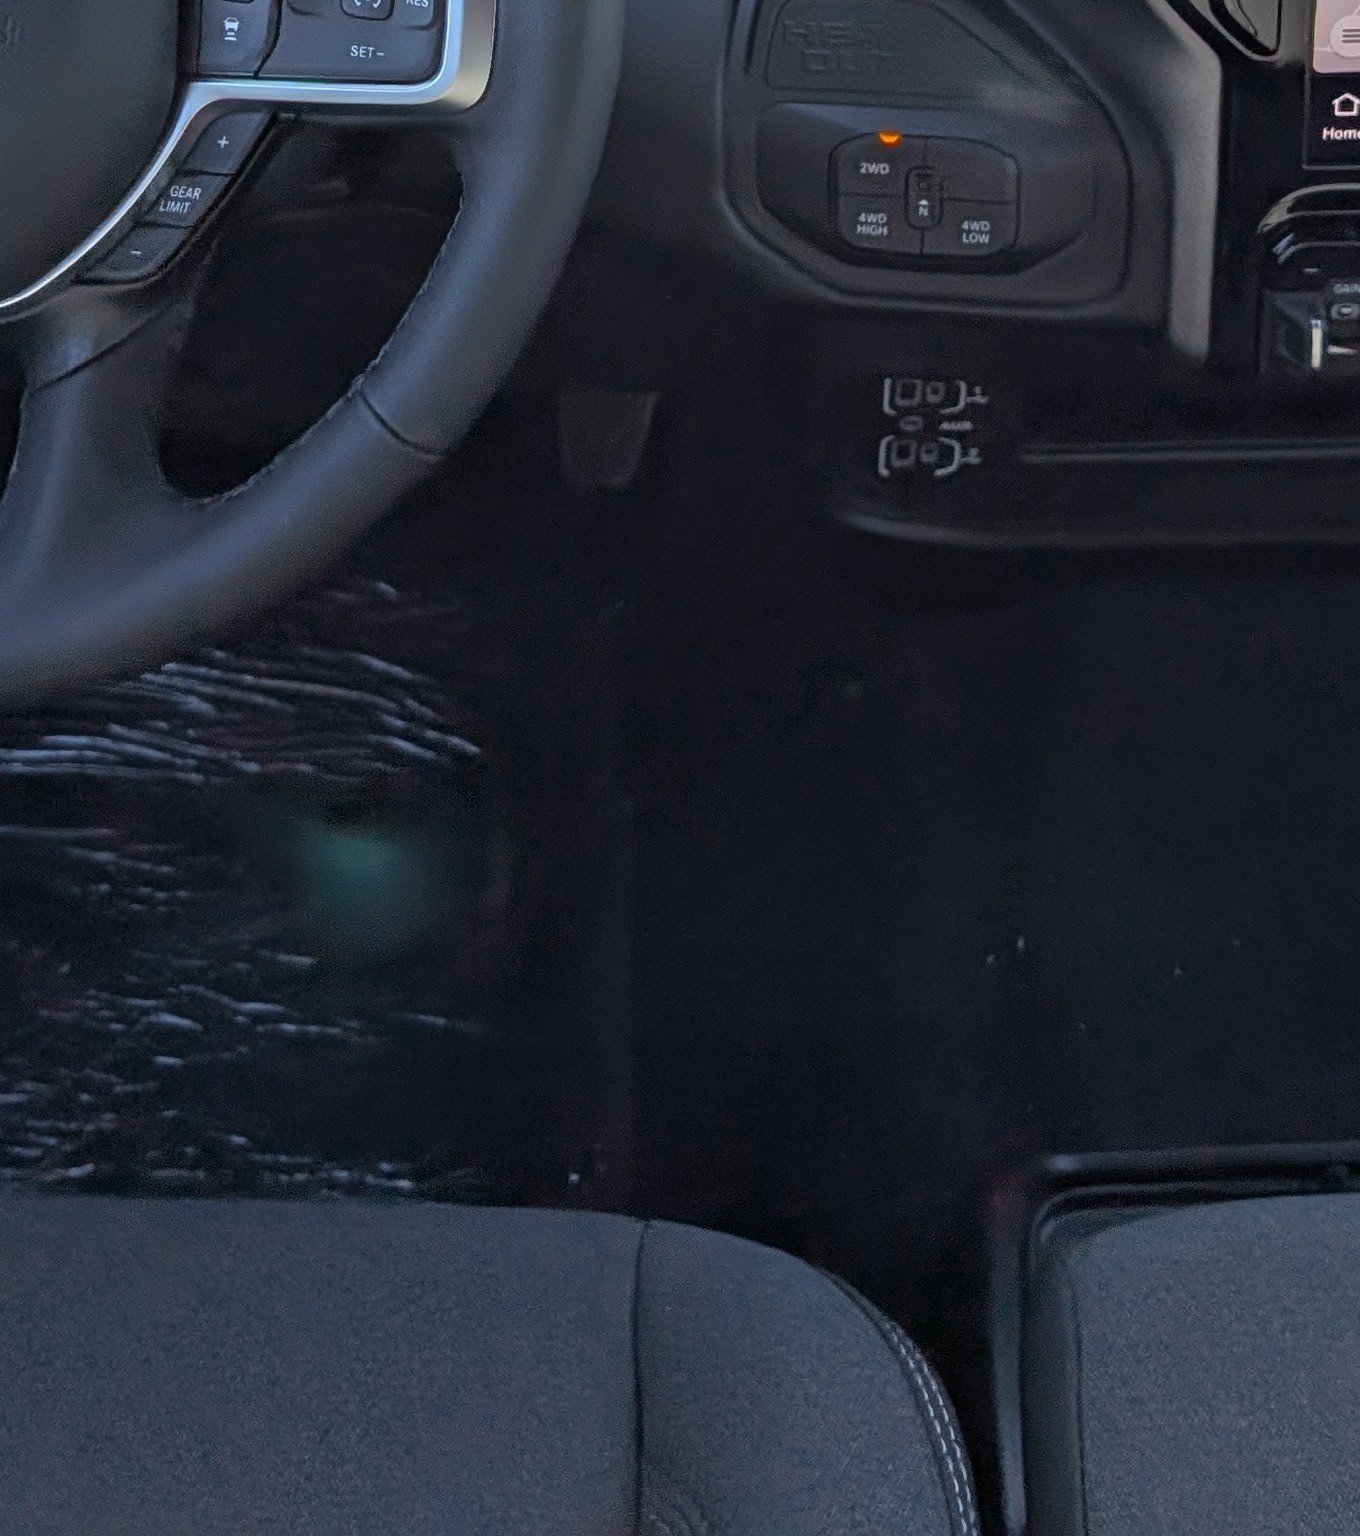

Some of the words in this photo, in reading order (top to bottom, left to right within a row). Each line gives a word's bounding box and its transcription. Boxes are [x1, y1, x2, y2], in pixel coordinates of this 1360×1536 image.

[859, 163, 890, 176] 2WD
[169, 185, 202, 200] GEAR
[158, 199, 191, 214] LIMIT
[858, 212, 888, 224] 4WD
[856, 223, 888, 237] HIGH
[961, 220, 991, 233] 4WD
[961, 232, 990, 245] LOW
